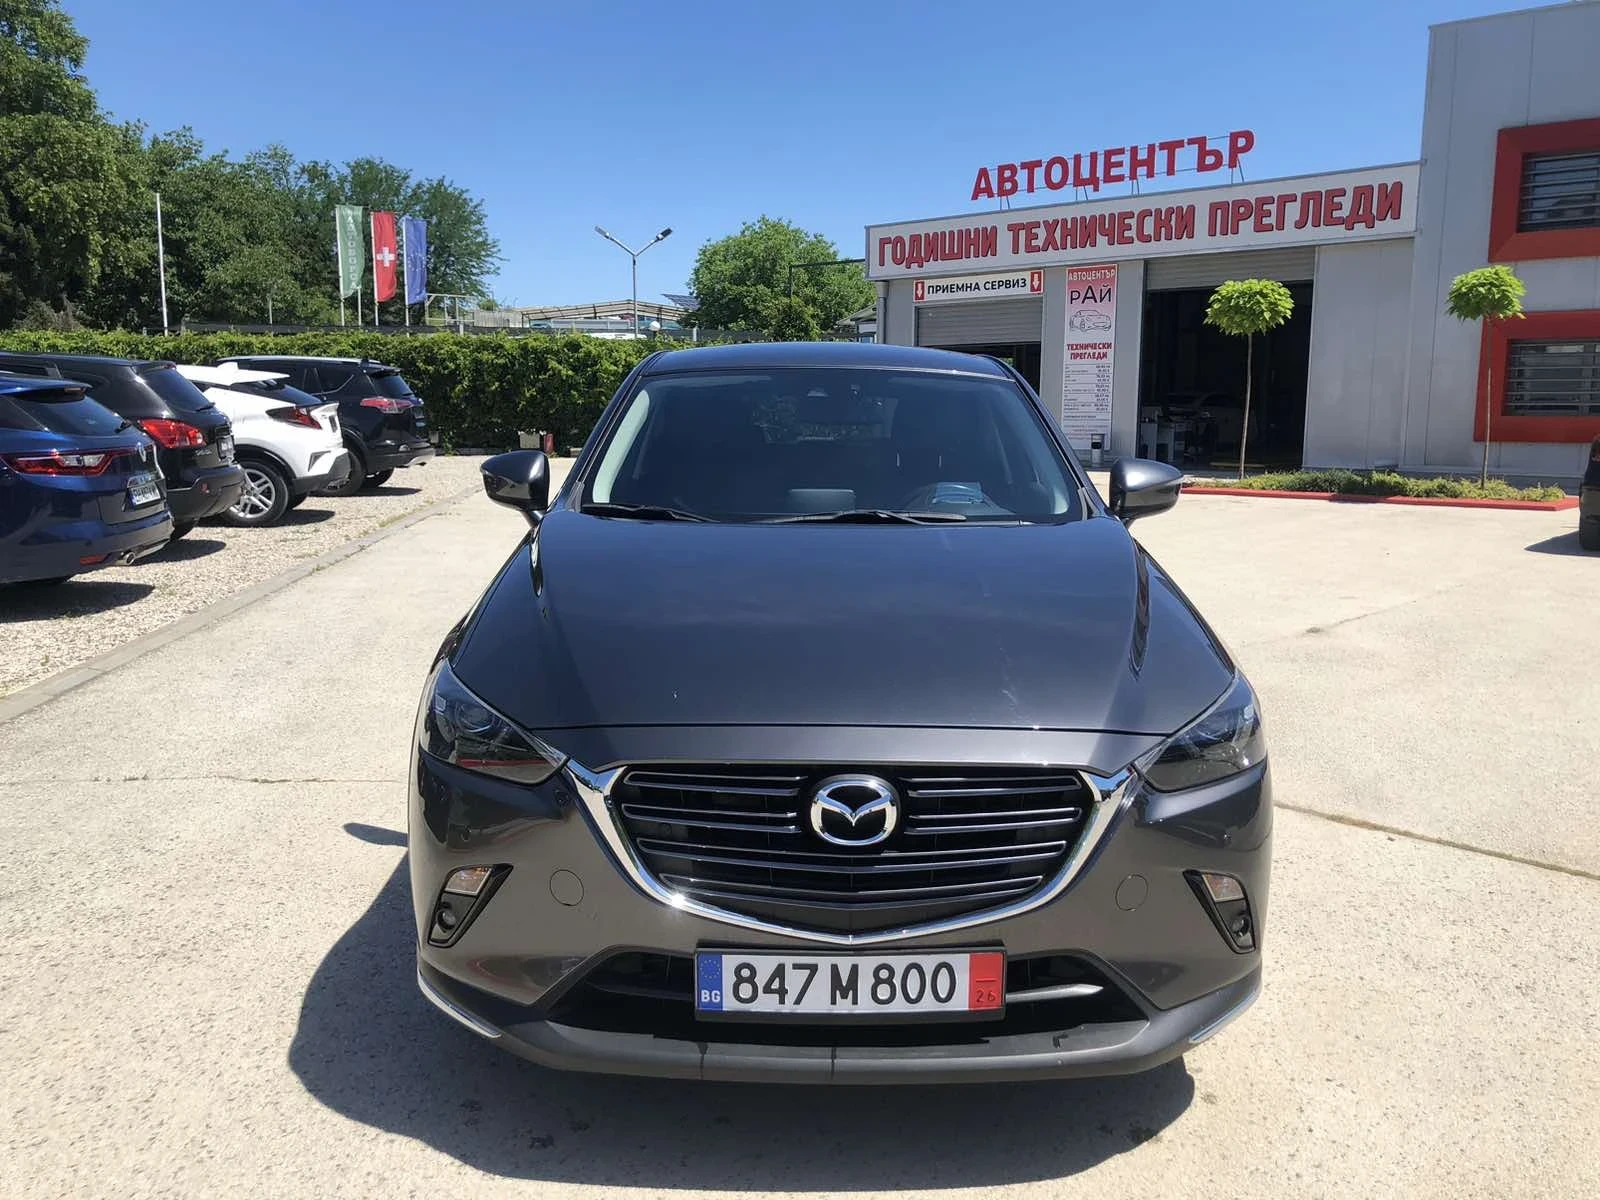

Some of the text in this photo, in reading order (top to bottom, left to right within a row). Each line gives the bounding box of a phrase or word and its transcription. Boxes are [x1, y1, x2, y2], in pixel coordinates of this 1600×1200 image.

[971, 130, 1255, 200] АВТОЦЕНТЪР
[878, 180, 1403, 269] ГОДИШНИ ТЕХНИЧЕСКИ ПРЕГЛЕДИ
[1068, 269, 1116, 281] АВТОЦЕНТЪР
[927, 278, 1027, 294] ПРИЕМНА СЕРВИЗ
[1070, 284, 1112, 304] РАЙ
[1066, 342, 1112, 351] ТЕХНИЧЕСКИ
[1070, 351, 1108, 360] ПРЕГЛЕДИ
[732, 961, 957, 1005] 847 M 800
[700, 989, 721, 1002] BG
